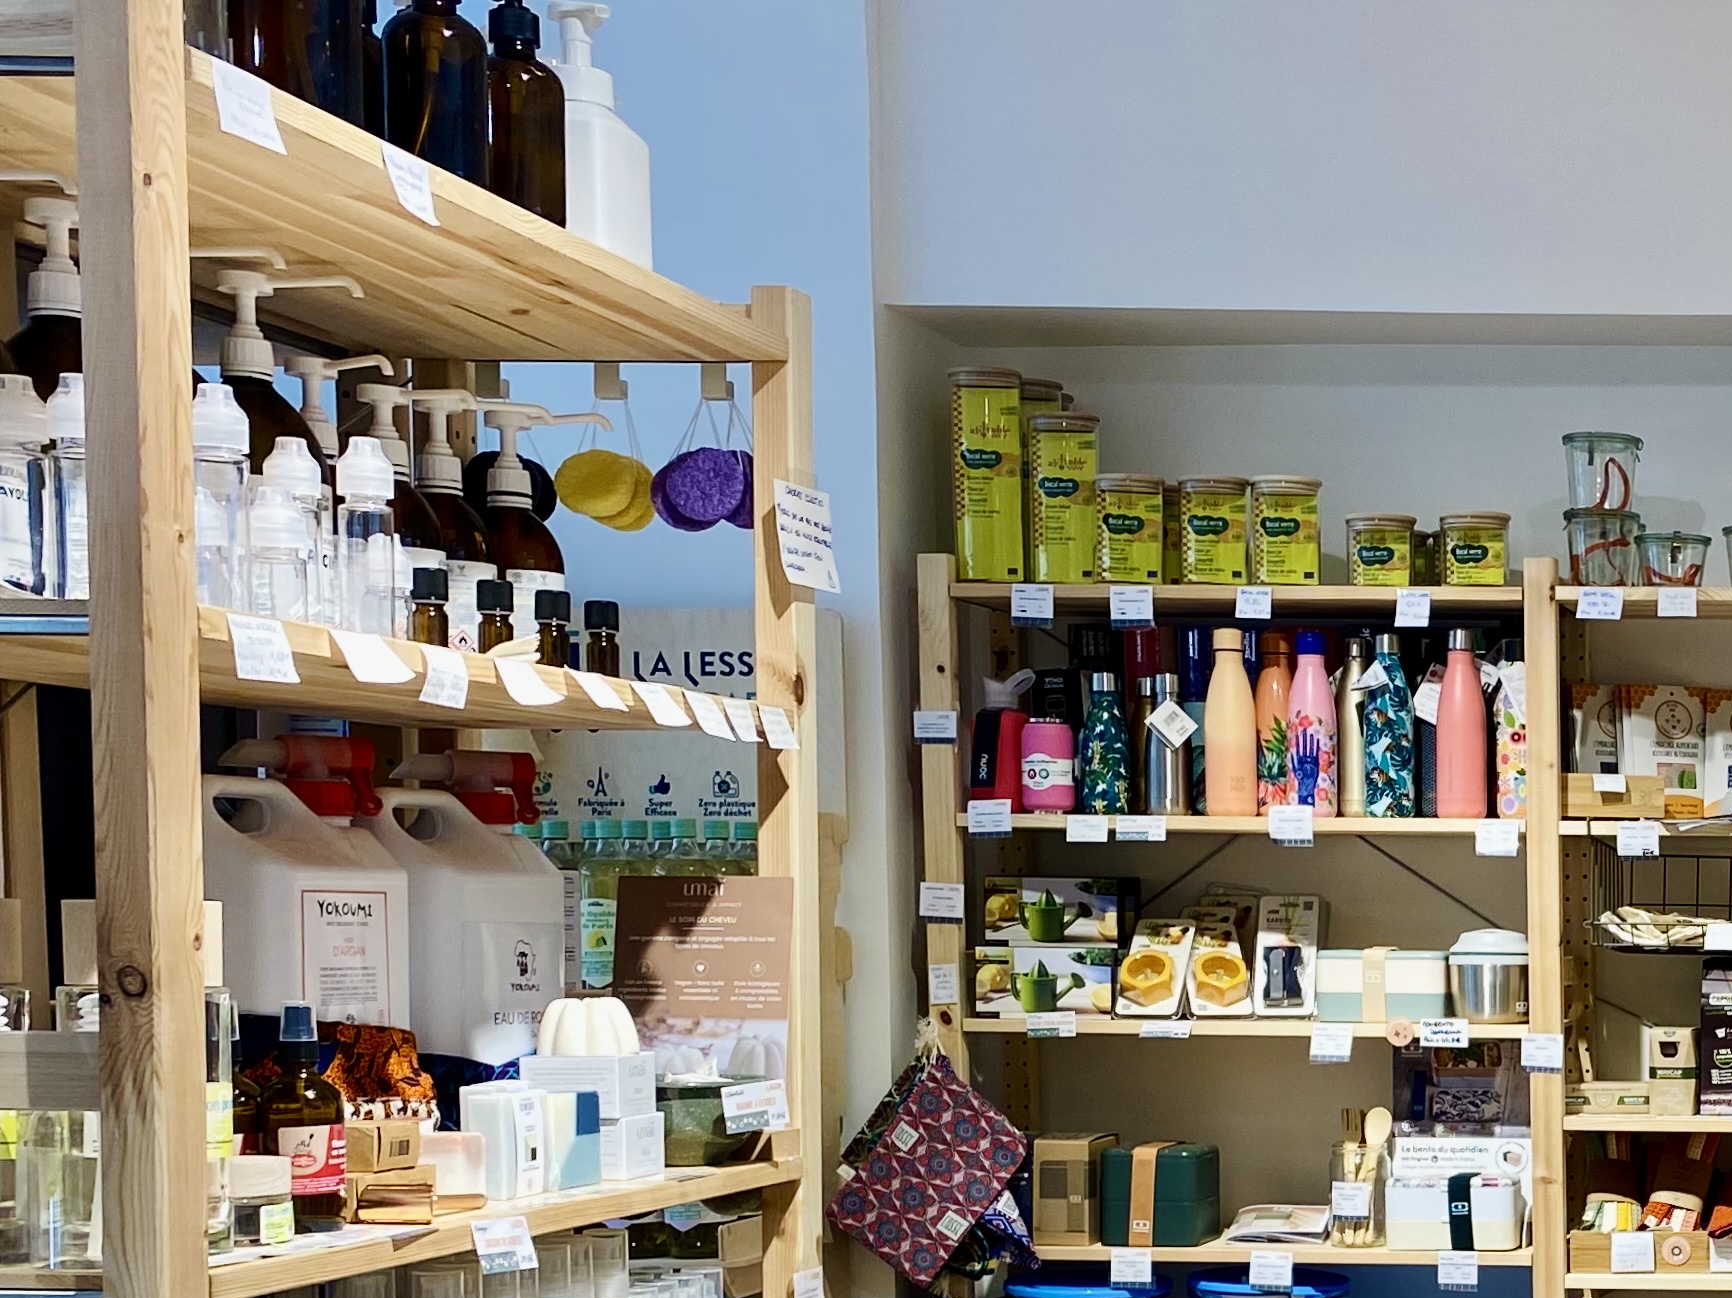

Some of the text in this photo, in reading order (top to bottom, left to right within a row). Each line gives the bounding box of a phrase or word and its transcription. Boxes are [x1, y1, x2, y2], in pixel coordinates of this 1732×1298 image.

[1044, 480, 1059, 488] Bocal
[1108, 518, 1138, 526] Bocal verre
[1193, 518, 1208, 528] Bocal
[1265, 519, 1294, 528] Bocal verre
[1456, 547, 1468, 555] Bocal
[633, 651, 672, 682] LA
[979, 753, 988, 781] nuoc
[578, 798, 619, 808] Fabriquée
[648, 799, 672, 808] Super
[719, 799, 756, 809] plastique
[592, 808, 612, 816] Paris
[645, 808, 677, 816] Efficace
[724, 808, 752, 817] déchet
[317, 899, 373, 918] YOKOUMI
[708, 916, 737, 924] CHEVEU
[511, 983, 540, 992] YOKOUMI
[494, 1012, 515, 1025] EAU
[517, 1011, 530, 1024] DE
[1412, 1145, 1437, 1153] bento
[1450, 1145, 1488, 1154] quotidien
